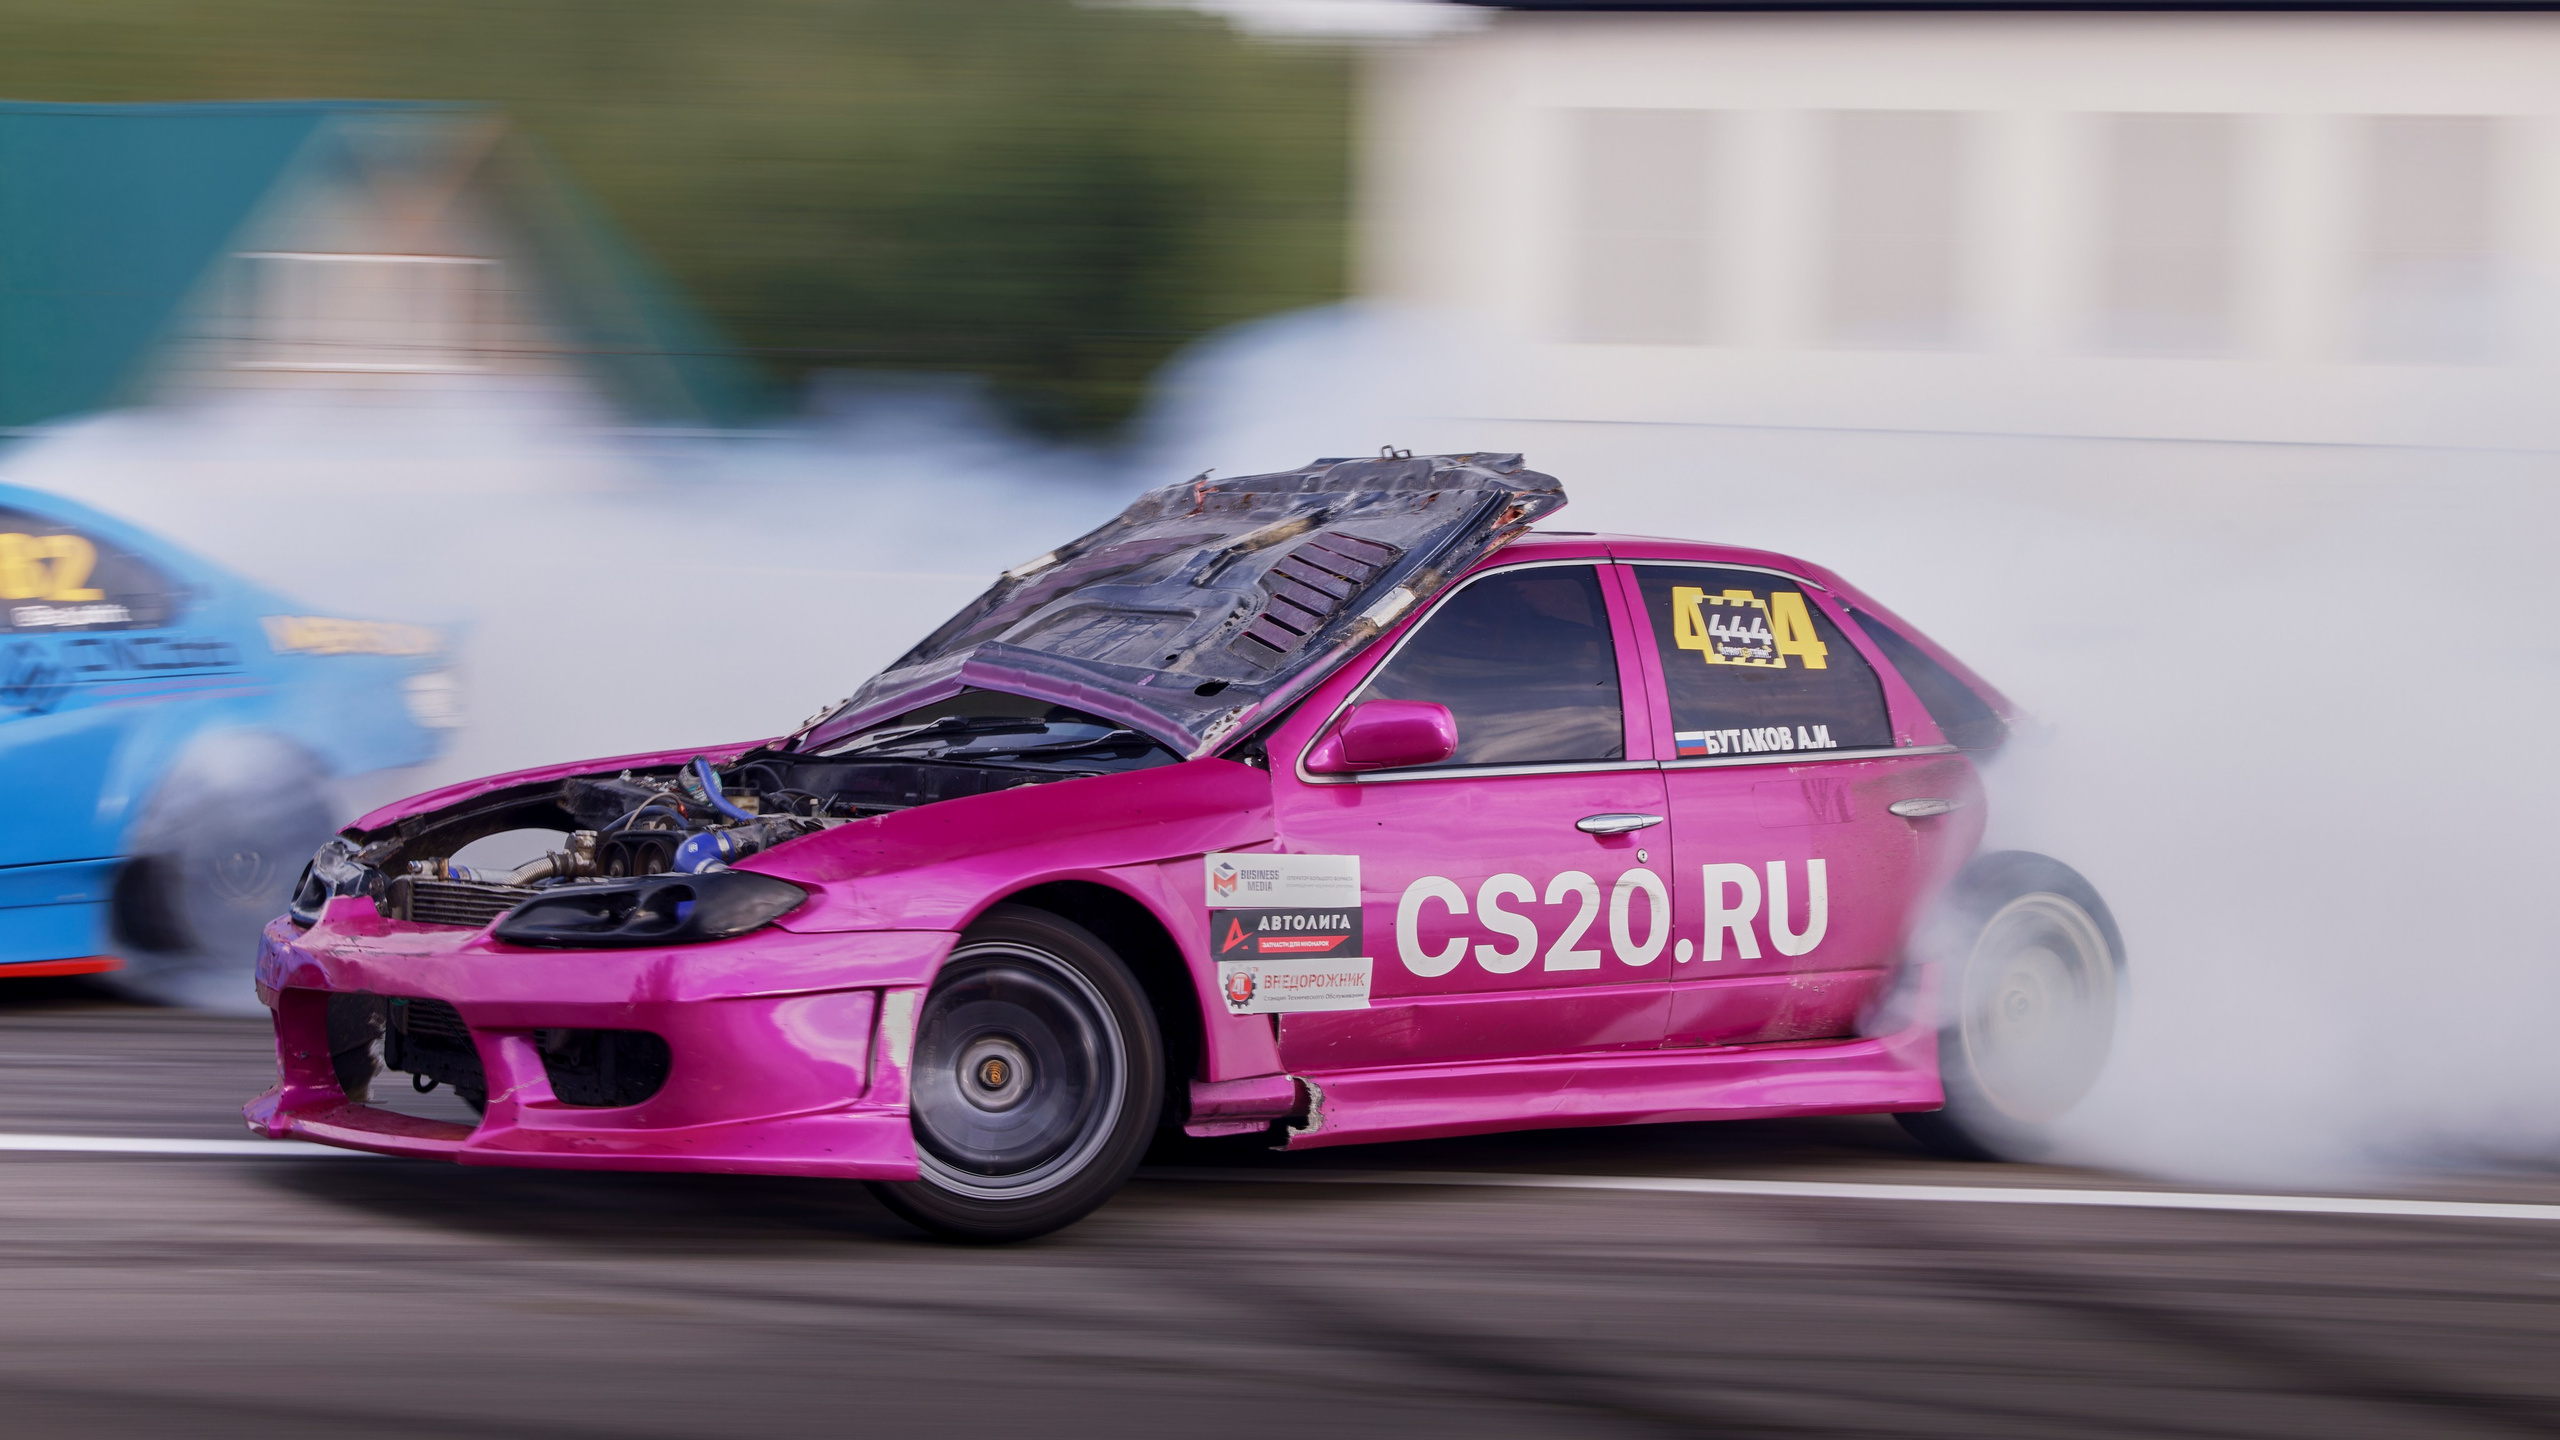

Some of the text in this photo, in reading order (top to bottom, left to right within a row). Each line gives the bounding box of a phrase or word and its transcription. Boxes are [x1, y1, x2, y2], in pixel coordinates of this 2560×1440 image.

[1708, 614, 1773, 645] 444
[1704, 725, 1837, 754] БУТАКОВ А.И.
[1241, 869, 1279, 880] BUSINESS
[1247, 881, 1273, 892] MEDIA
[1257, 914, 1351, 931] АВТОЛИГА
[1396, 858, 1828, 977] CS20.RU
[1264, 972, 1366, 991] ВНЕДОРОЖНИК
